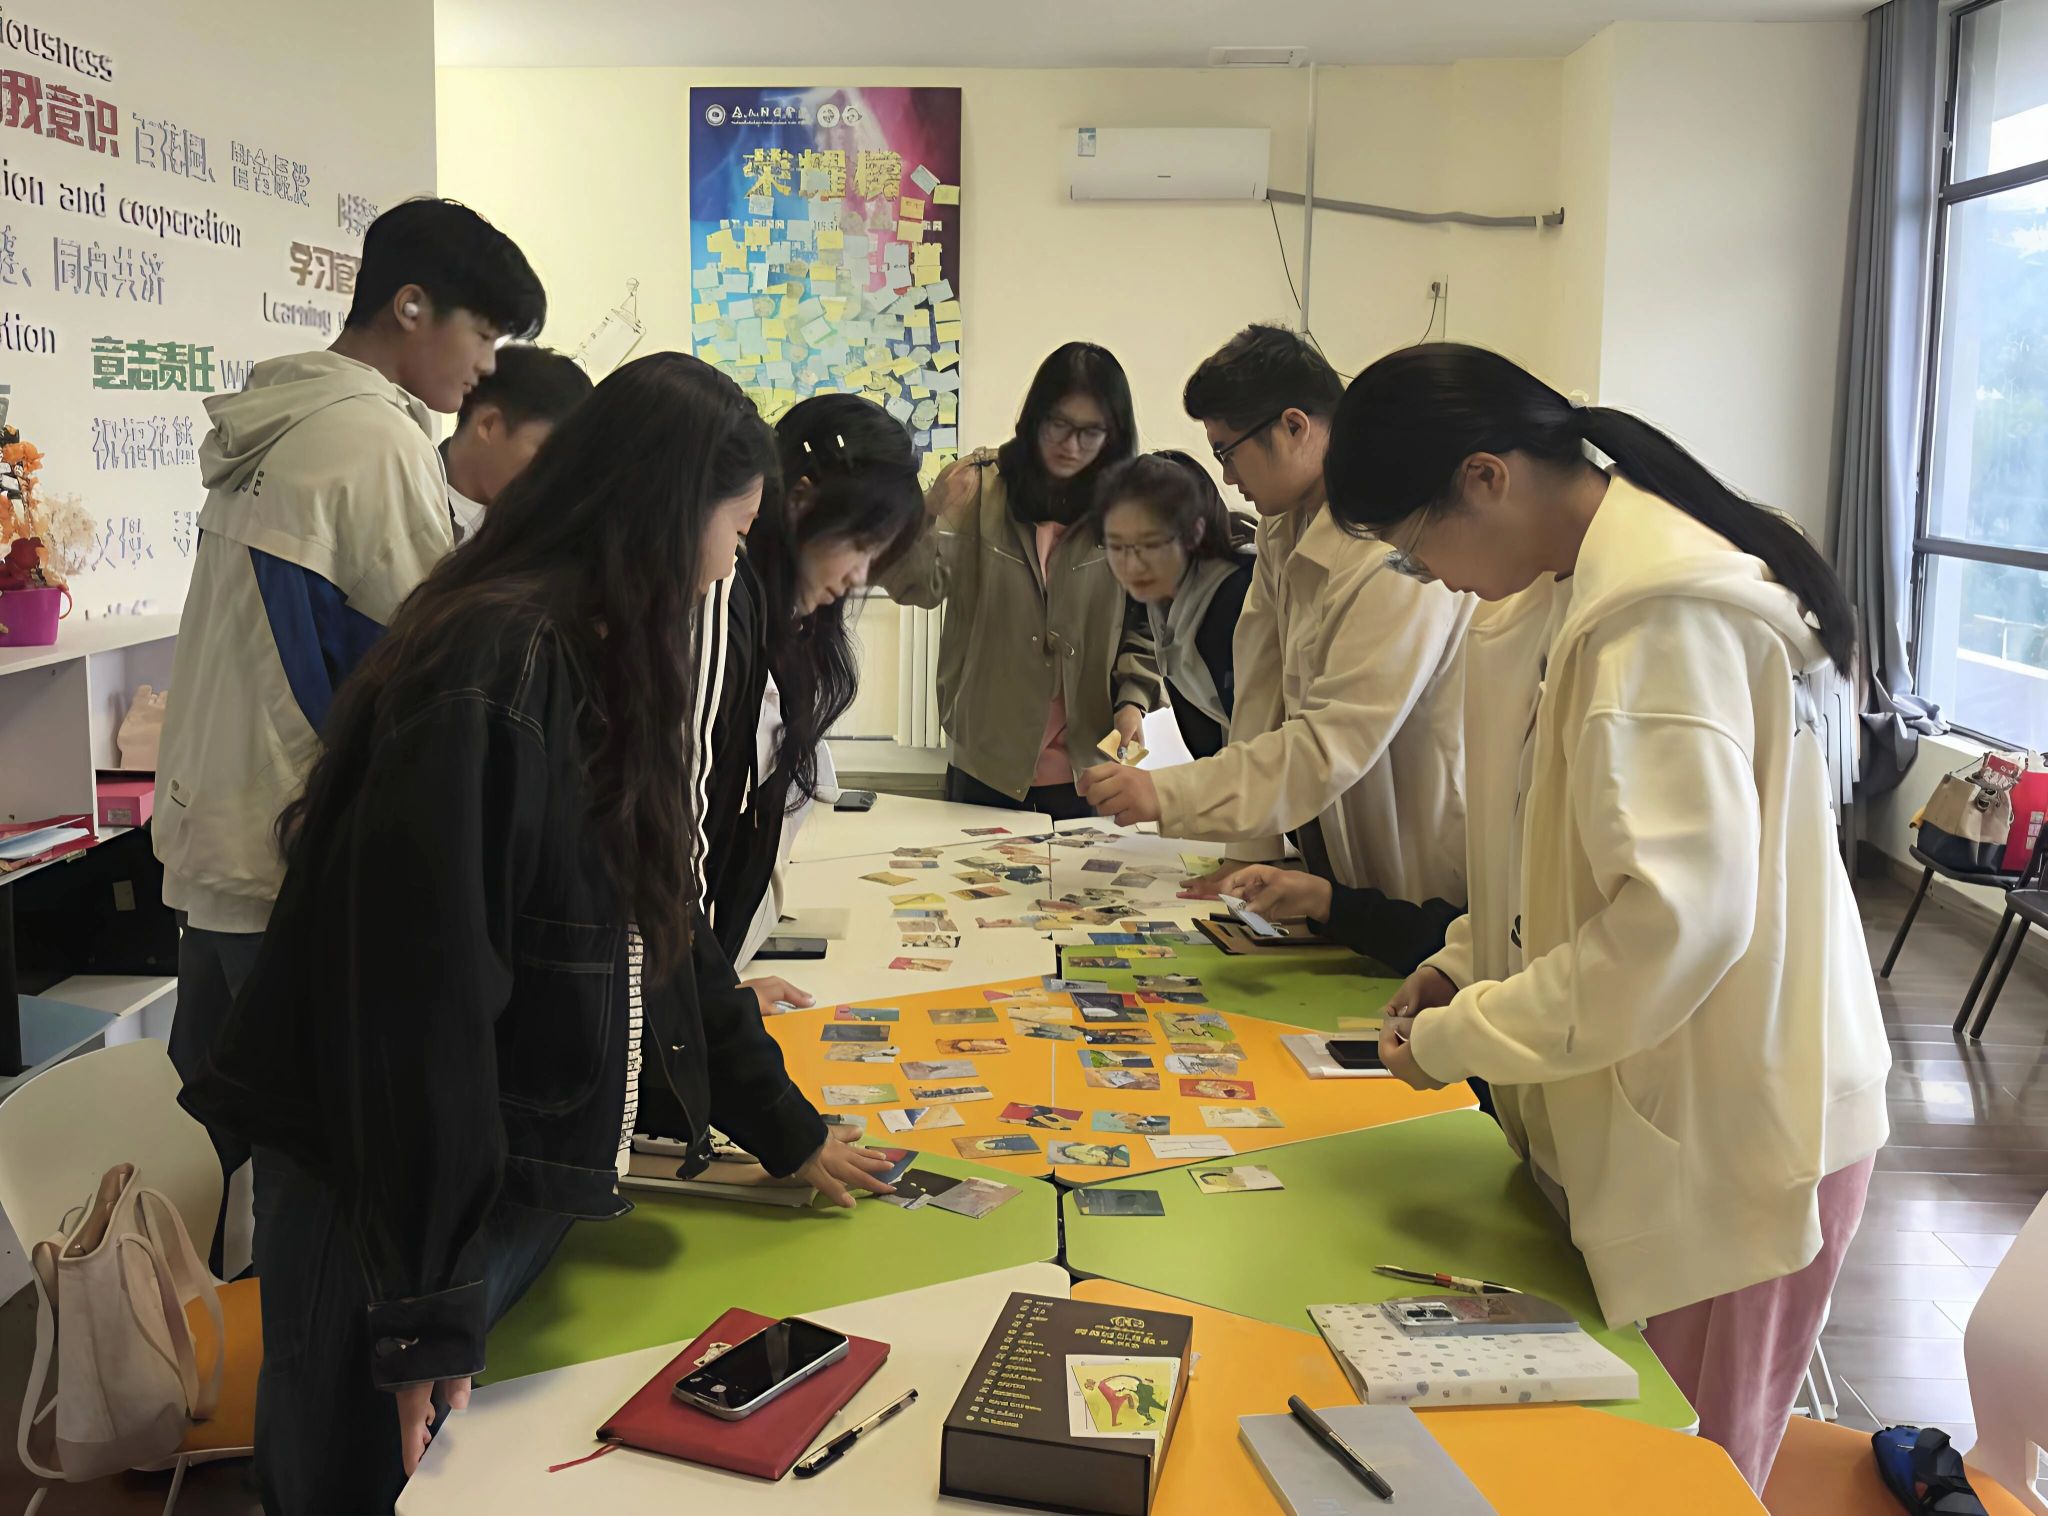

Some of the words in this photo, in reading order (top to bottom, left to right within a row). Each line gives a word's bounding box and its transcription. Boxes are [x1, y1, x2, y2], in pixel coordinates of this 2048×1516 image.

[59, 182, 107, 217] and
[118, 197, 241, 248] cooperation
[263, 292, 332, 336] Learning
[91, 335, 215, 392] 意志责任
